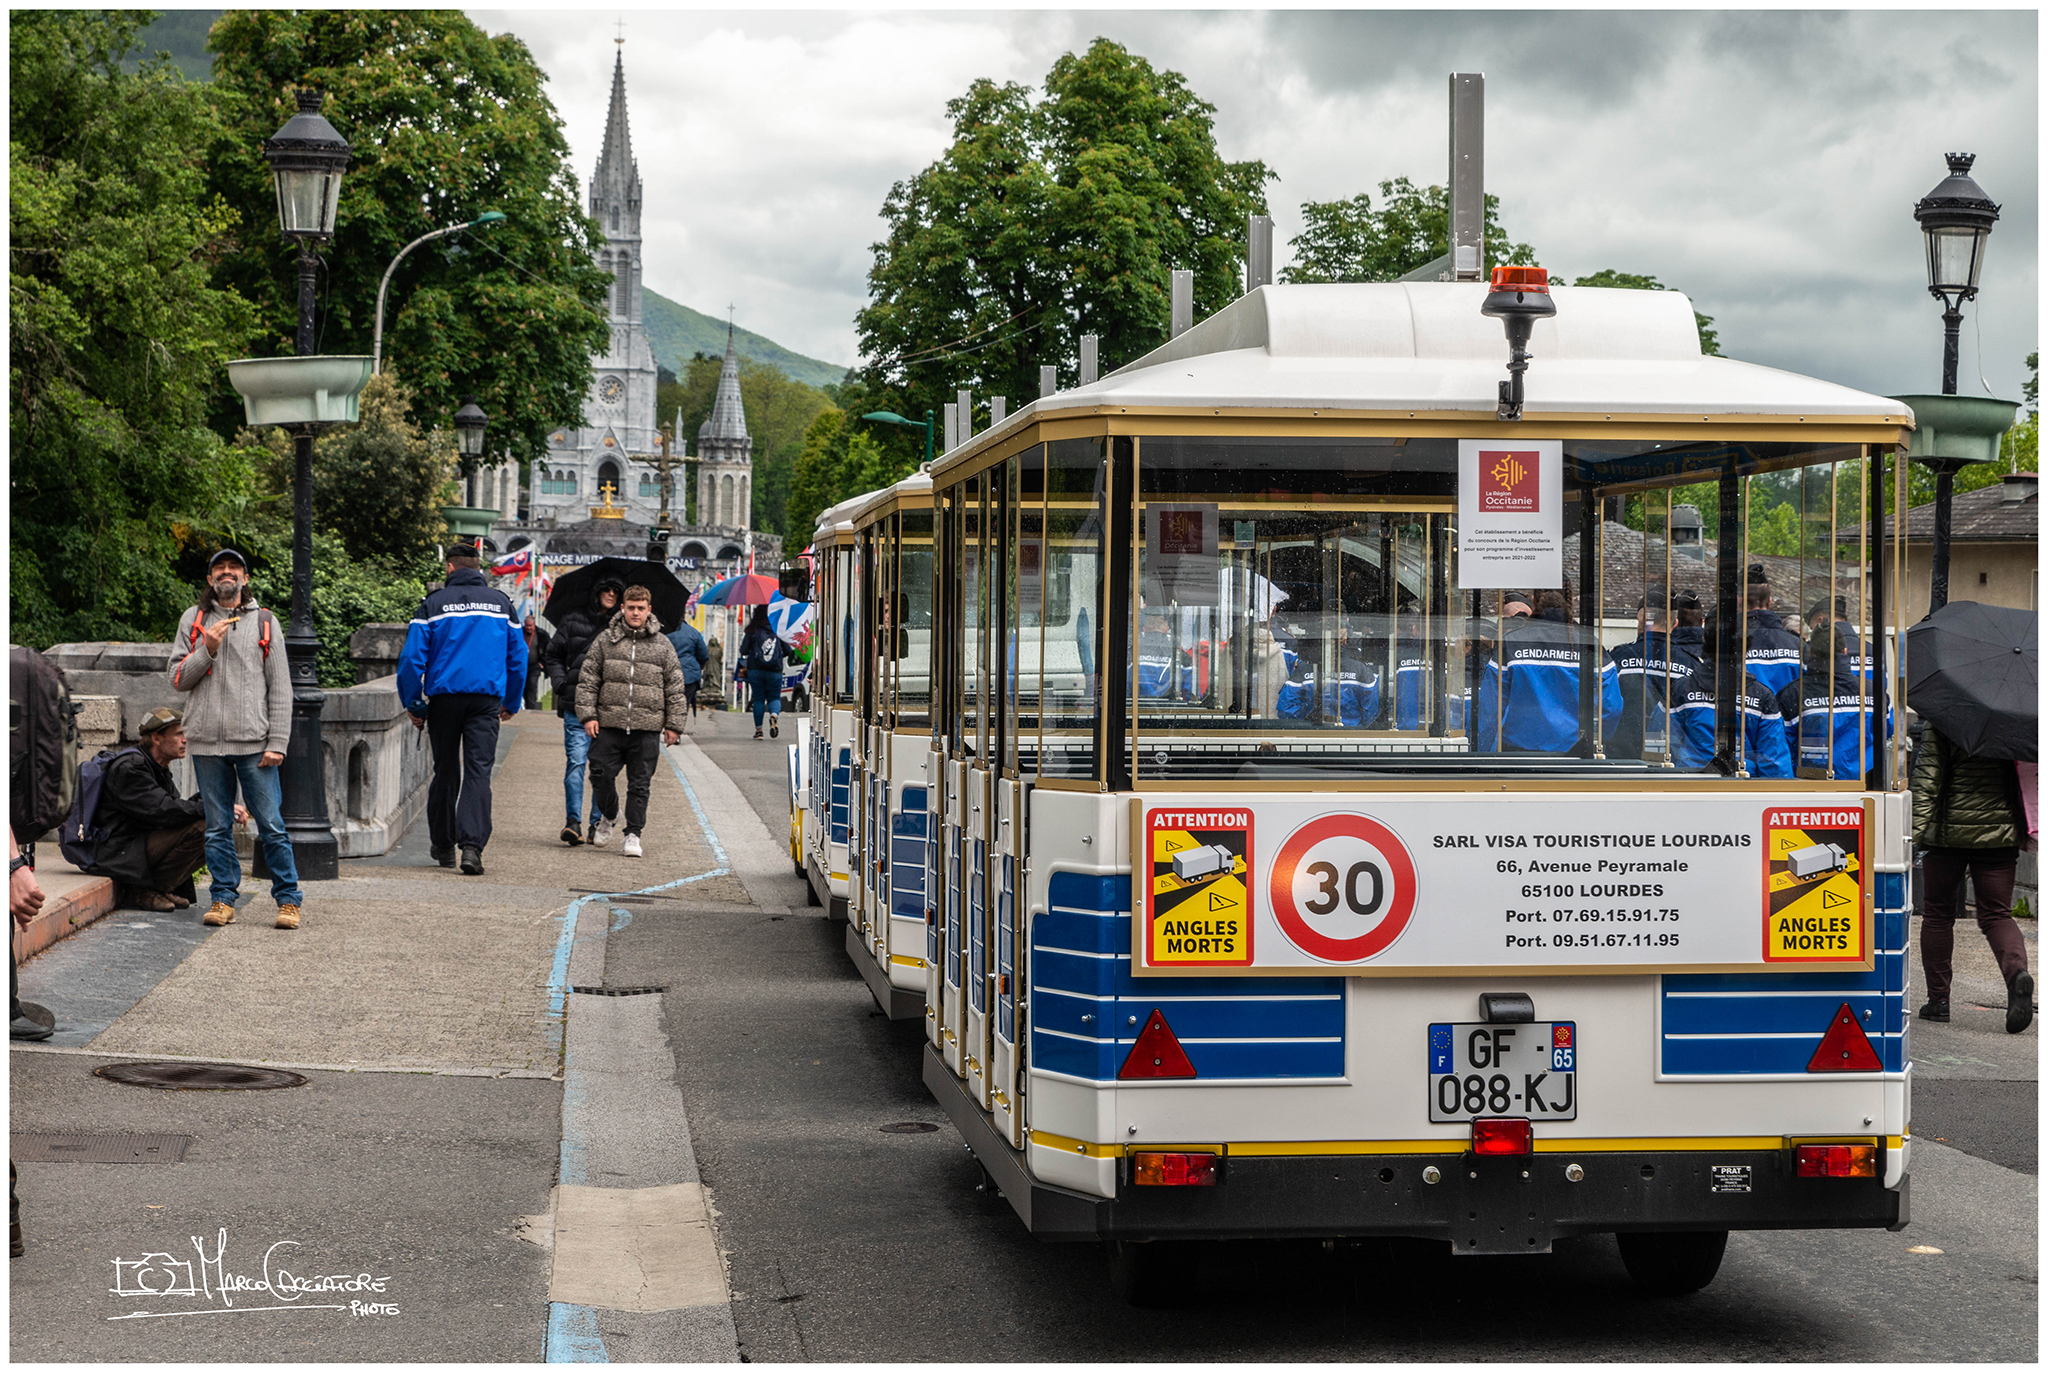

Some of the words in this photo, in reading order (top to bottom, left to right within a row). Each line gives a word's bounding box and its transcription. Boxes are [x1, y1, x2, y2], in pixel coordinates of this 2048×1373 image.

[442, 602, 502, 613] GENDARMERIE
[1153, 813, 1248, 827] ATTENTION
[1769, 812, 1861, 826] ATTENTION
[1432, 835, 1480, 848] SARL
[1485, 834, 1528, 848] VISA
[1533, 834, 1656, 848] TOURISTIQUE
[1661, 834, 1752, 848] LOURDAIS
[1496, 860, 1523, 875] 66,
[1528, 860, 1592, 873] Avenue
[1597, 859, 1689, 875] Peyramale
[1304, 860, 1385, 916] 30
[1521, 885, 1574, 898] 65100
[1579, 884, 1664, 898] LOURDES
[1505, 909, 1548, 923] Port.
[1552, 909, 1680, 923] 07.69.15.91.75
[1162, 920, 1239, 937] ANGLES
[1778, 917, 1852, 933] ANGLES
[1167, 938, 1235, 954] MORTS
[1505, 934, 1548, 948] Port.
[1552, 934, 1680, 948] 09.51.67.11.95
[1782, 935, 1848, 951] MORTS
[1468, 1028, 1516, 1069] GF
[1438, 1055, 1446, 1067] F
[1553, 1048, 1573, 1068] 65
[1438, 1073, 1573, 1115] 088-KJ
[1720, 1167, 1742, 1175] PRAT
